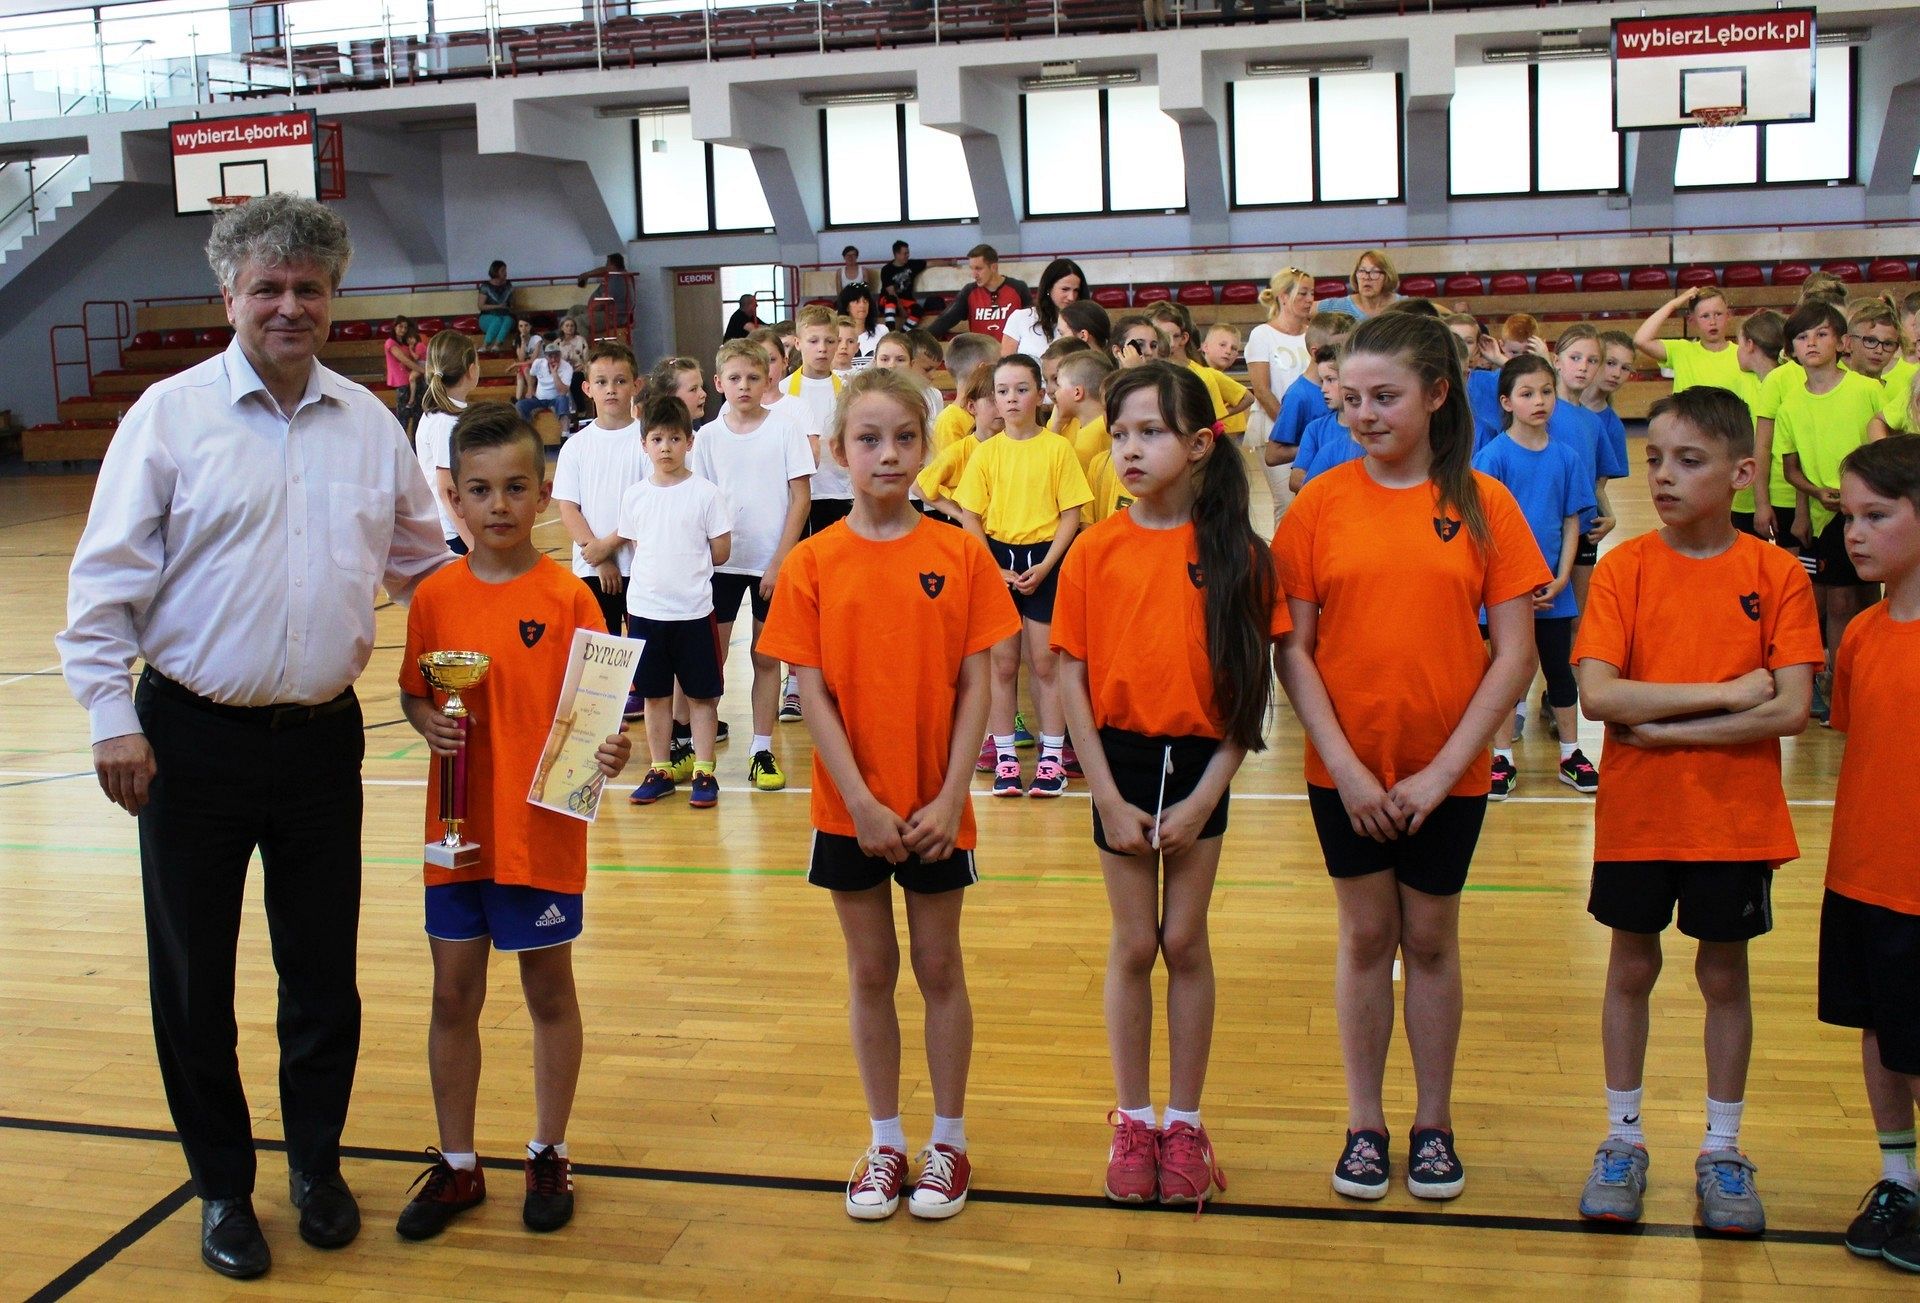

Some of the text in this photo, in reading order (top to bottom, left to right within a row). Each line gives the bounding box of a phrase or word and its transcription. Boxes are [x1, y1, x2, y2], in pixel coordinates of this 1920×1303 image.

[1622, 20, 1805, 52] wybierzLębork.pl
[176, 120, 308, 149] wybierzLębork.pl
[975, 303, 1012, 321] HEAT
[583, 642, 633, 668] DYPLOM
[535, 915, 566, 927] adidas
